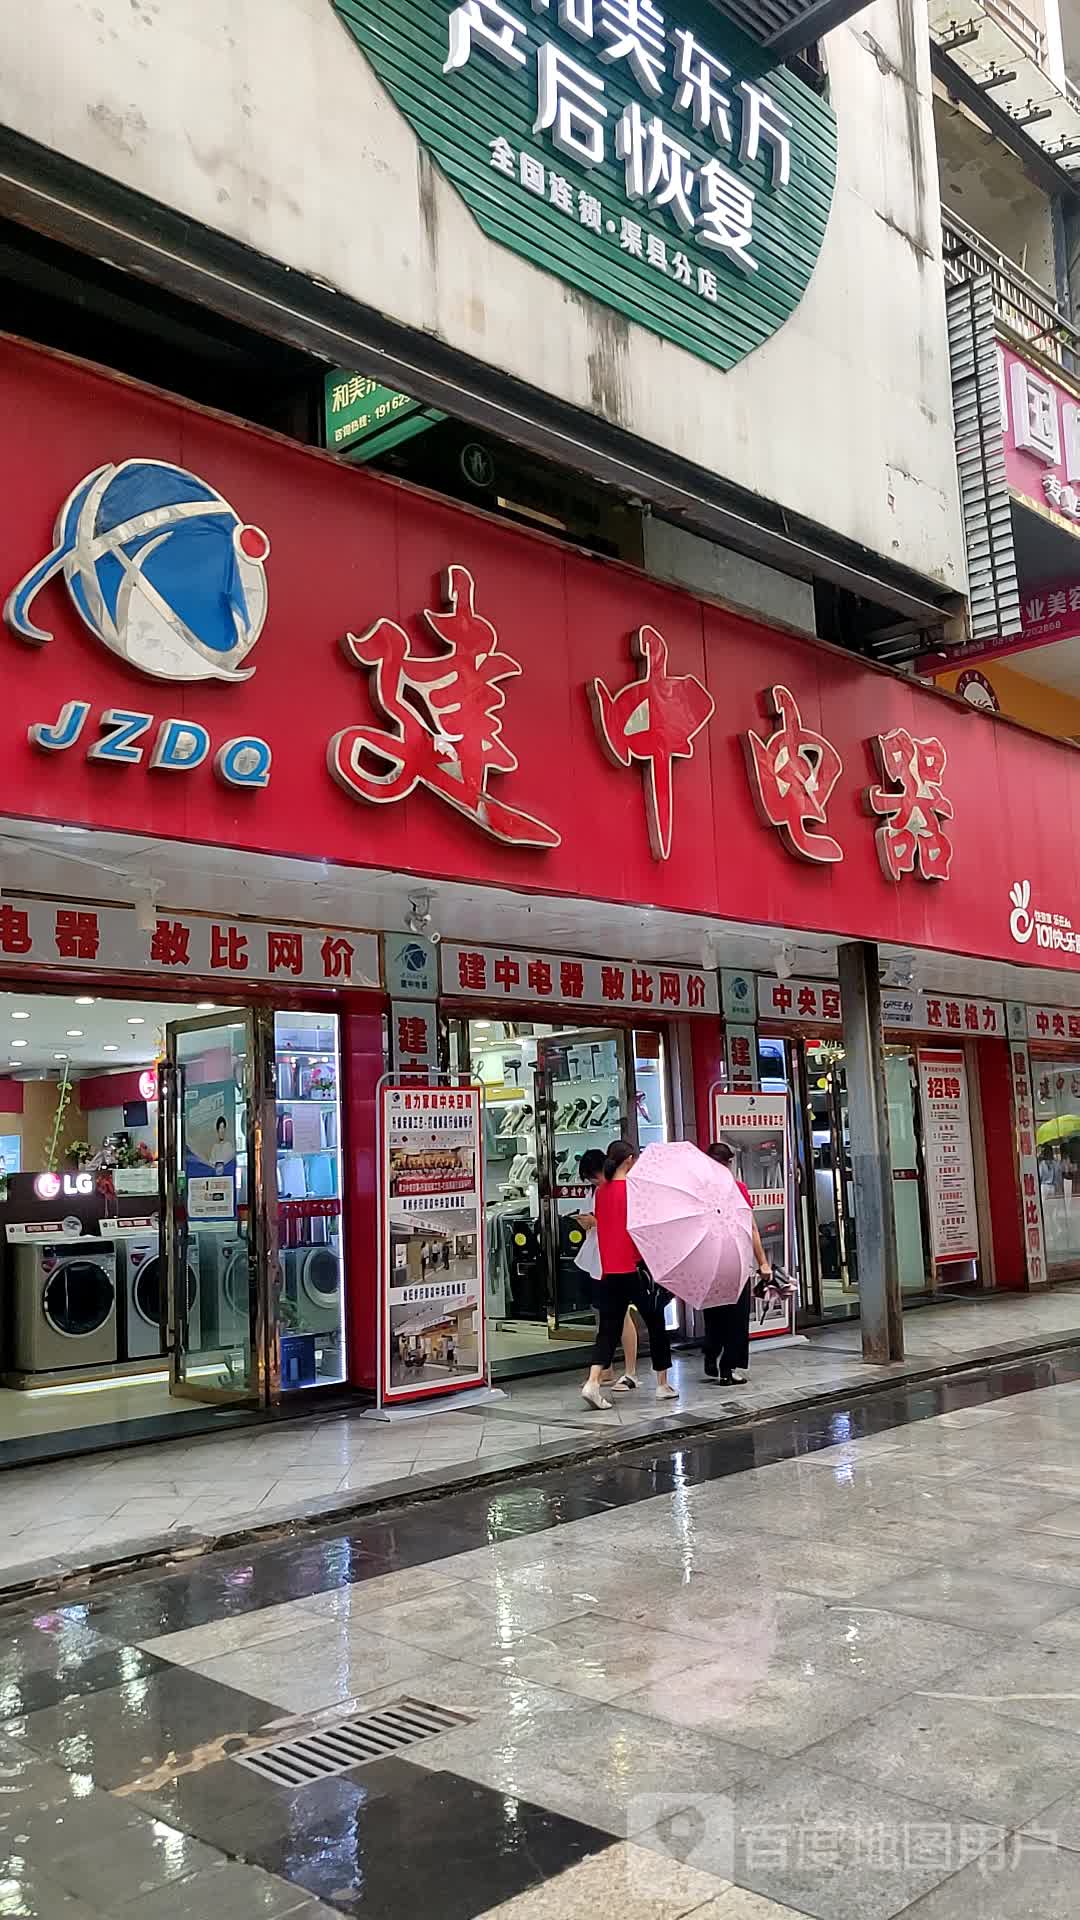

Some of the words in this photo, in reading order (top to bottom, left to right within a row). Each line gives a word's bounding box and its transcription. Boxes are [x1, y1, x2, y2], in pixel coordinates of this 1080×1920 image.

[443, 0, 760, 275] 产后恢复
[27, 698, 273, 791] JZDQ
[327, 562, 954, 885] 建中电器
[151, 920, 355, 978] 敢比网价
[458, 951, 585, 999] 建中电器
[600, 965, 706, 1008] 敢比网价
[927, 1077, 960, 1098] 招聘
[63, 1173, 93, 1195] LG
